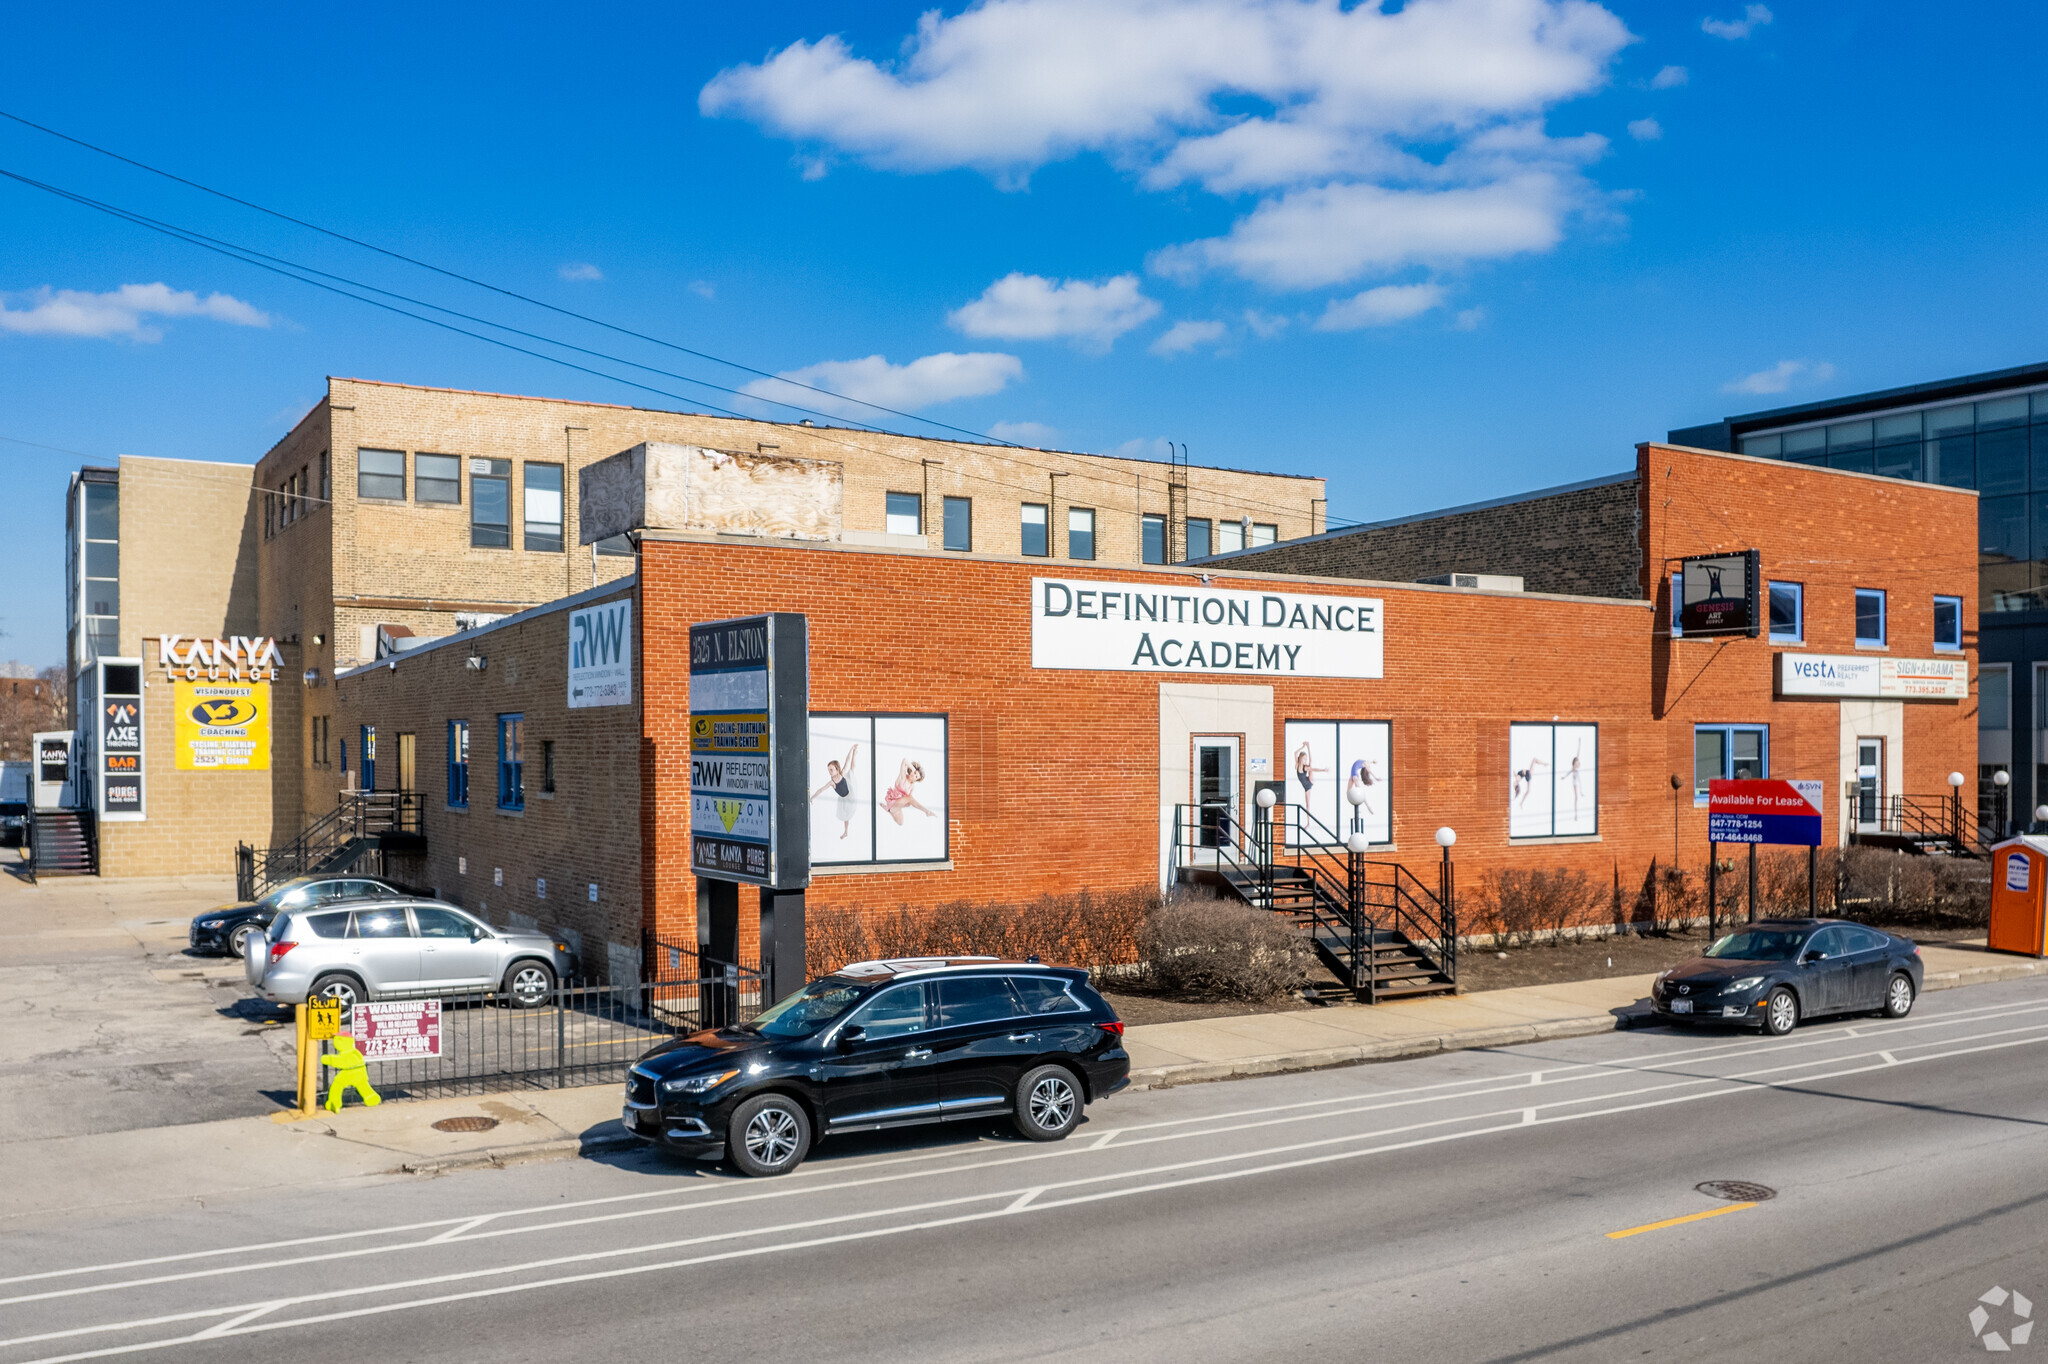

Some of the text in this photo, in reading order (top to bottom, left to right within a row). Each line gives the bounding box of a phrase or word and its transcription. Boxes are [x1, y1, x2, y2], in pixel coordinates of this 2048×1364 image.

[1043, 582, 1375, 633] DEFINITION DANCE
[1696, 602, 1734, 613] GENESIS
[160, 633, 285, 667] KANYA
[693, 627, 764, 664] 2525 N. ELSTON
[1131, 632, 1302, 671] ACADEMY
[167, 667, 279, 681] LOUNGE
[1837, 664, 1869, 672] PREFERRED
[106, 726, 138, 740] AXE
[199, 728, 248, 737] COACHING
[714, 735, 759, 748] TRAINING CENTER
[41, 749, 67, 760] KANYA
[108, 756, 136, 768] BAR
[725, 762, 769, 777] REFLECTION
[726, 778, 749, 789] WINDOW
[1805, 783, 1821, 791] SVN
[1711, 795, 1804, 806] Available For Lease
[695, 798, 764, 817] BARBIZON
[1711, 832, 1762, 842] 847-464-8468
[720, 844, 743, 864] KANYA
[368, 1002, 426, 1014] WARNING
[365, 1036, 430, 1051] 773-237-0006
